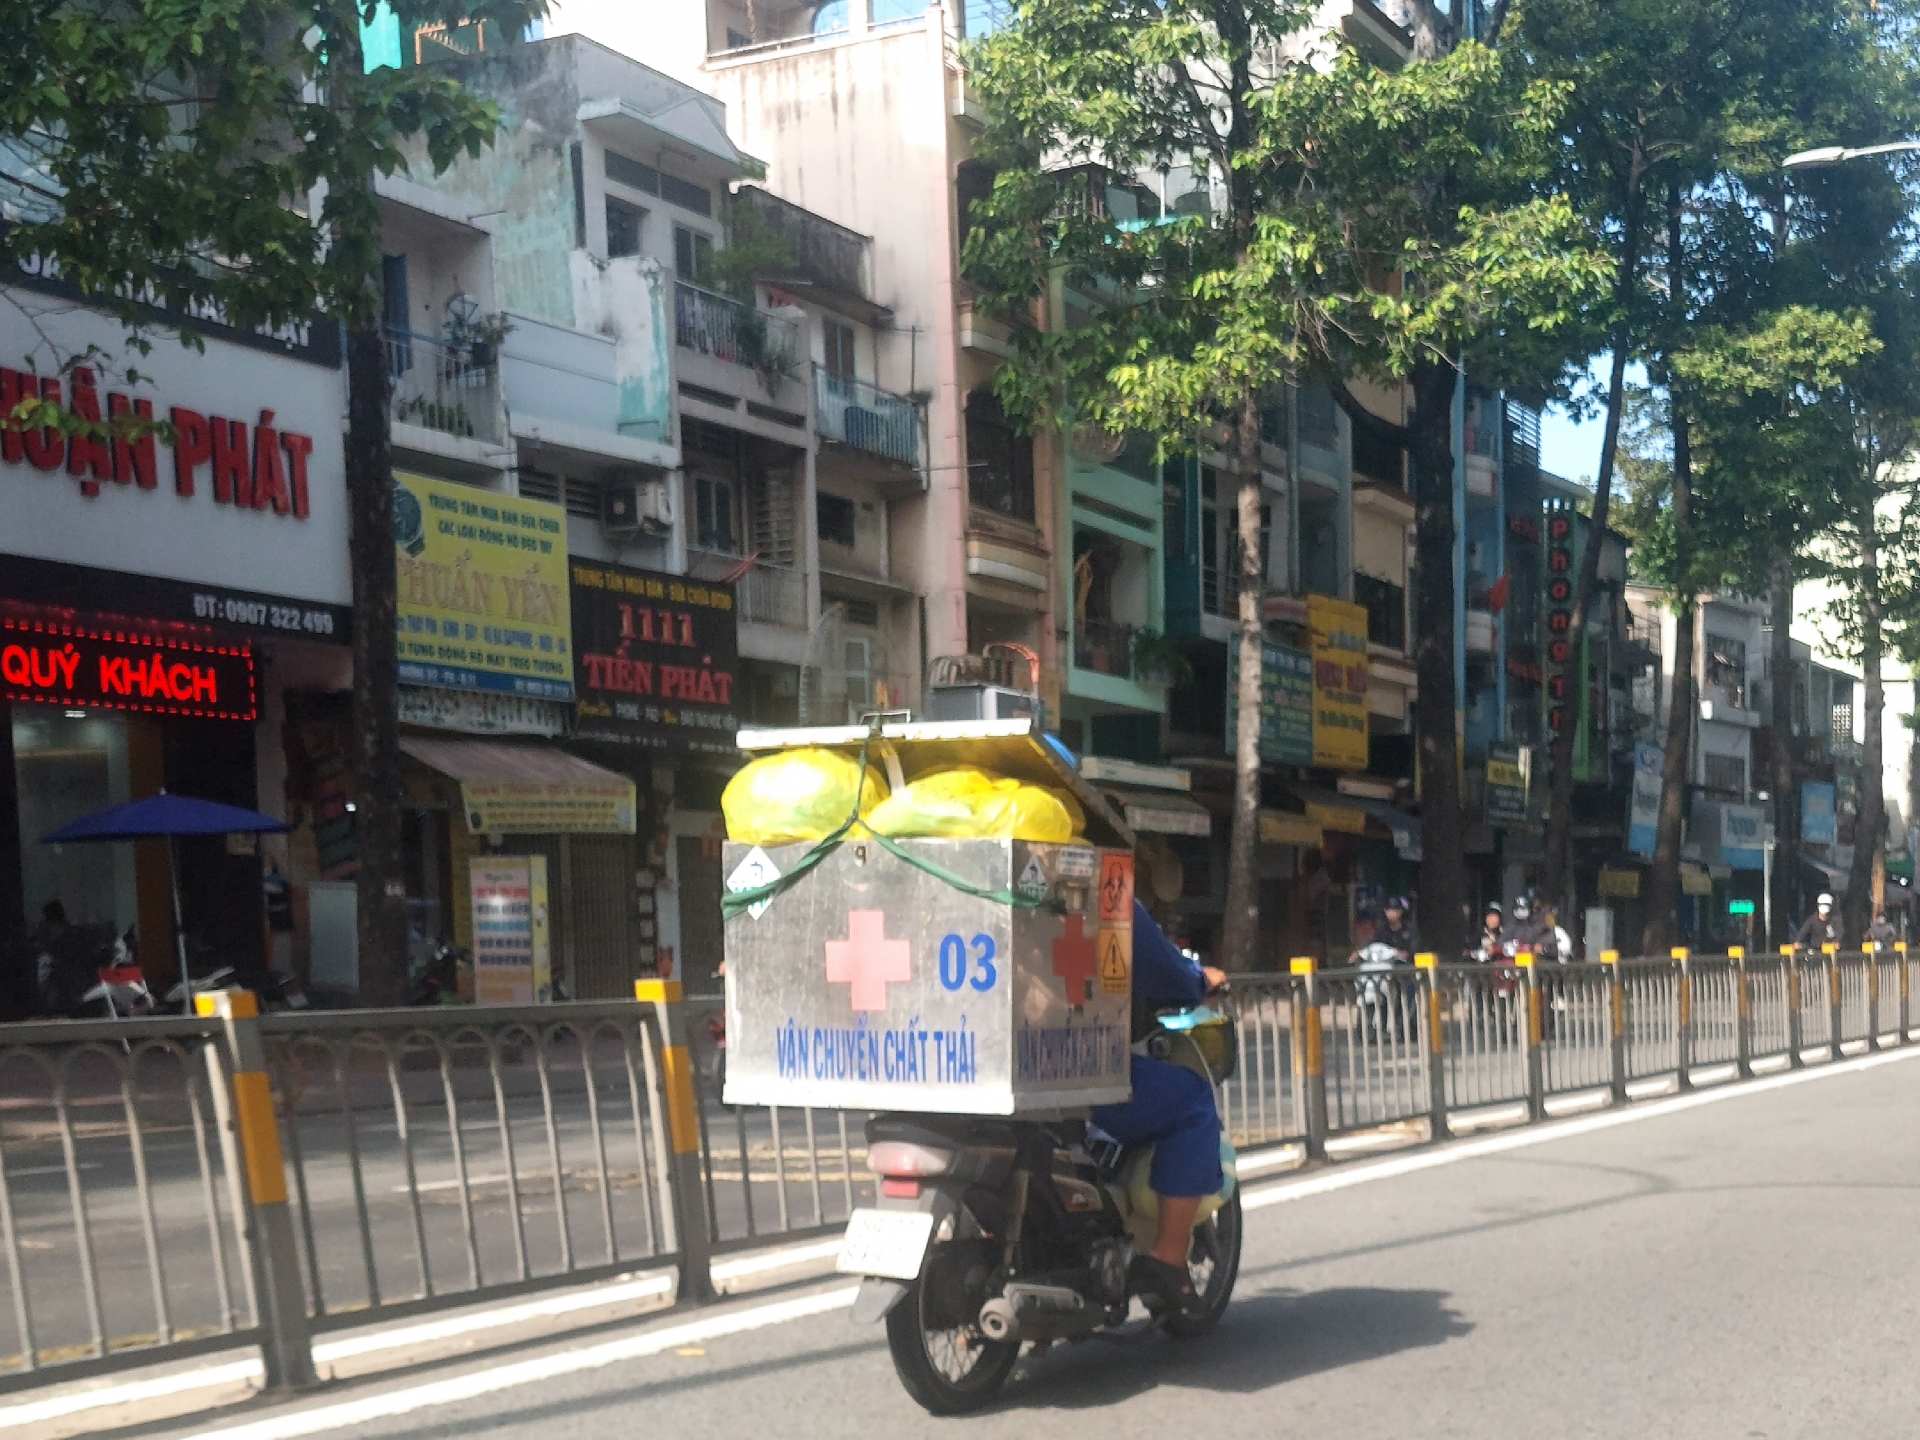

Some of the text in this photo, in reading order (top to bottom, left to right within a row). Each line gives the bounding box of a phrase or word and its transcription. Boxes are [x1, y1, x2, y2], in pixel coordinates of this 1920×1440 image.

[170, 407, 313, 519] PHÁT
[270, 603, 301, 631] 322
[618, 603, 696, 647] 1111
[2, 643, 217, 703] QUÝ KHÁCH
[939, 933, 997, 992] 03
[776, 1011, 976, 1084] VẬN CHUYỂN CHẤT THẢI
